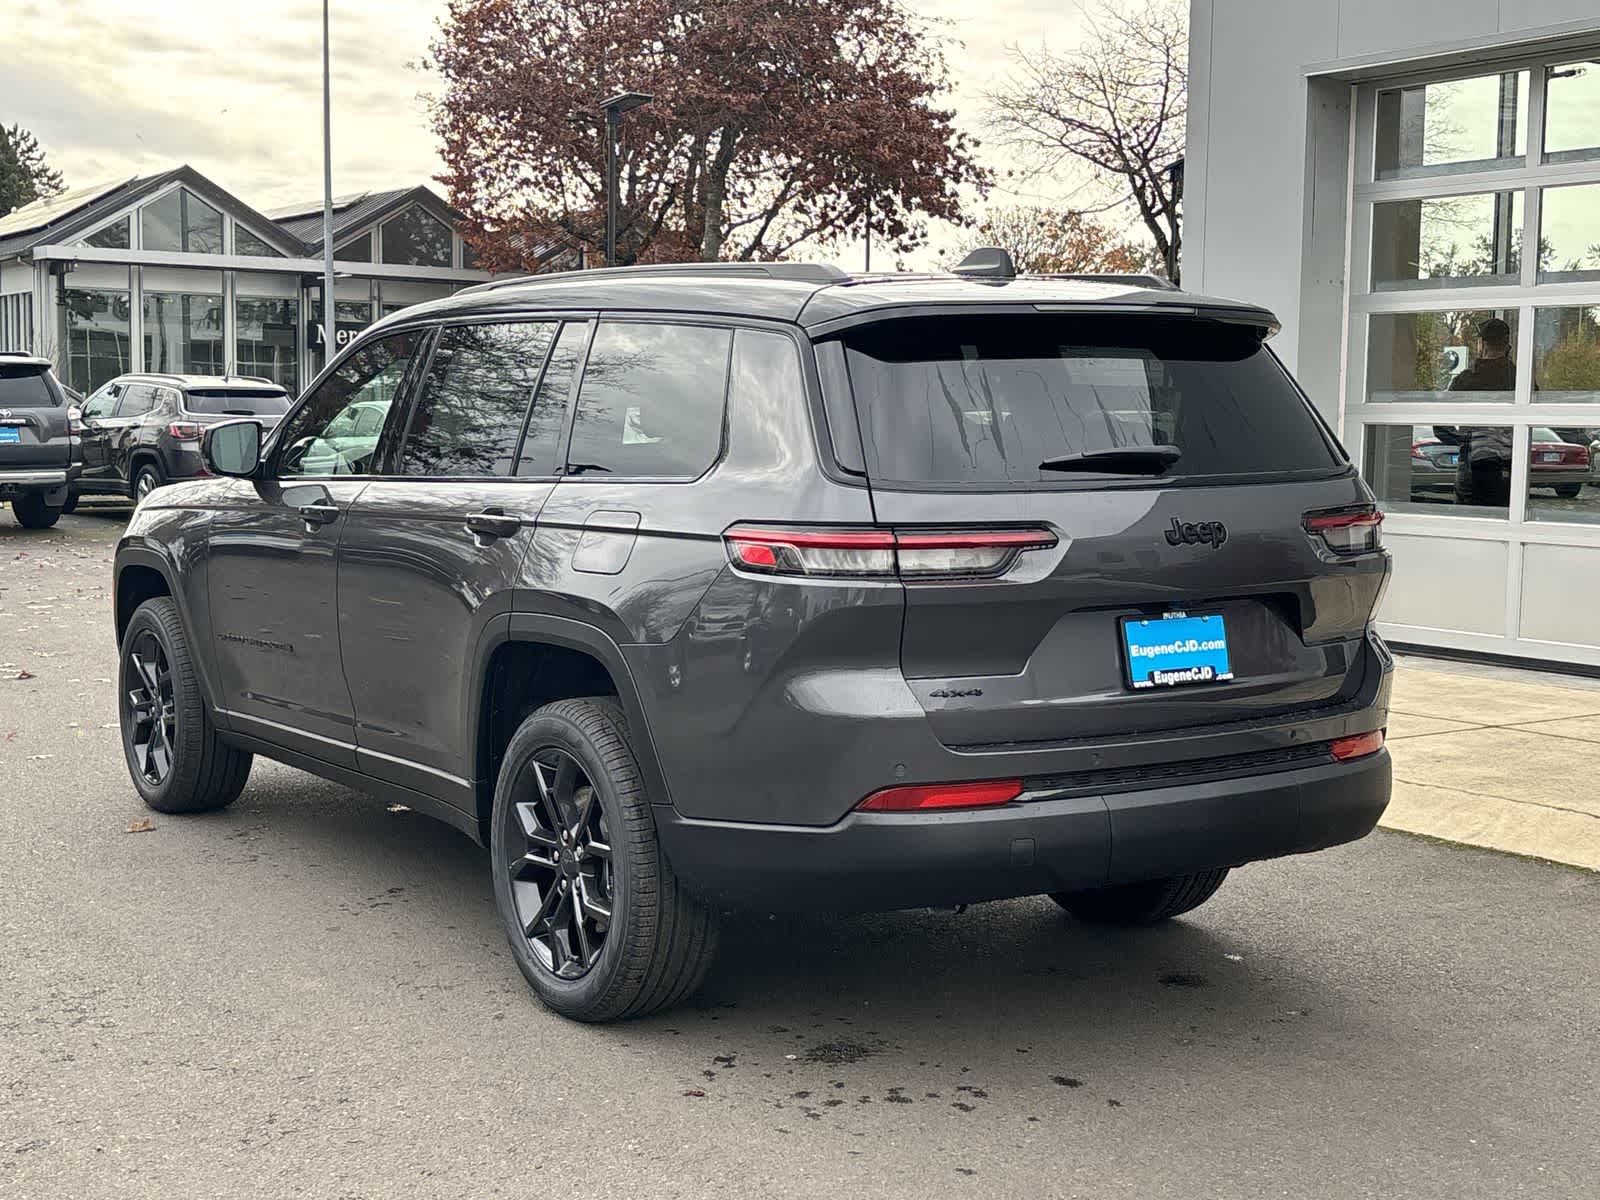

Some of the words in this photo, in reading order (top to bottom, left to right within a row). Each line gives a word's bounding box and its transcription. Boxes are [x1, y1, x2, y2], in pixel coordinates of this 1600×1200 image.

[1164, 517, 1227, 549] Jeep
[1130, 639, 1225, 658] EugeneCJD.com
[1153, 666, 1213, 685] EugeneCJD
